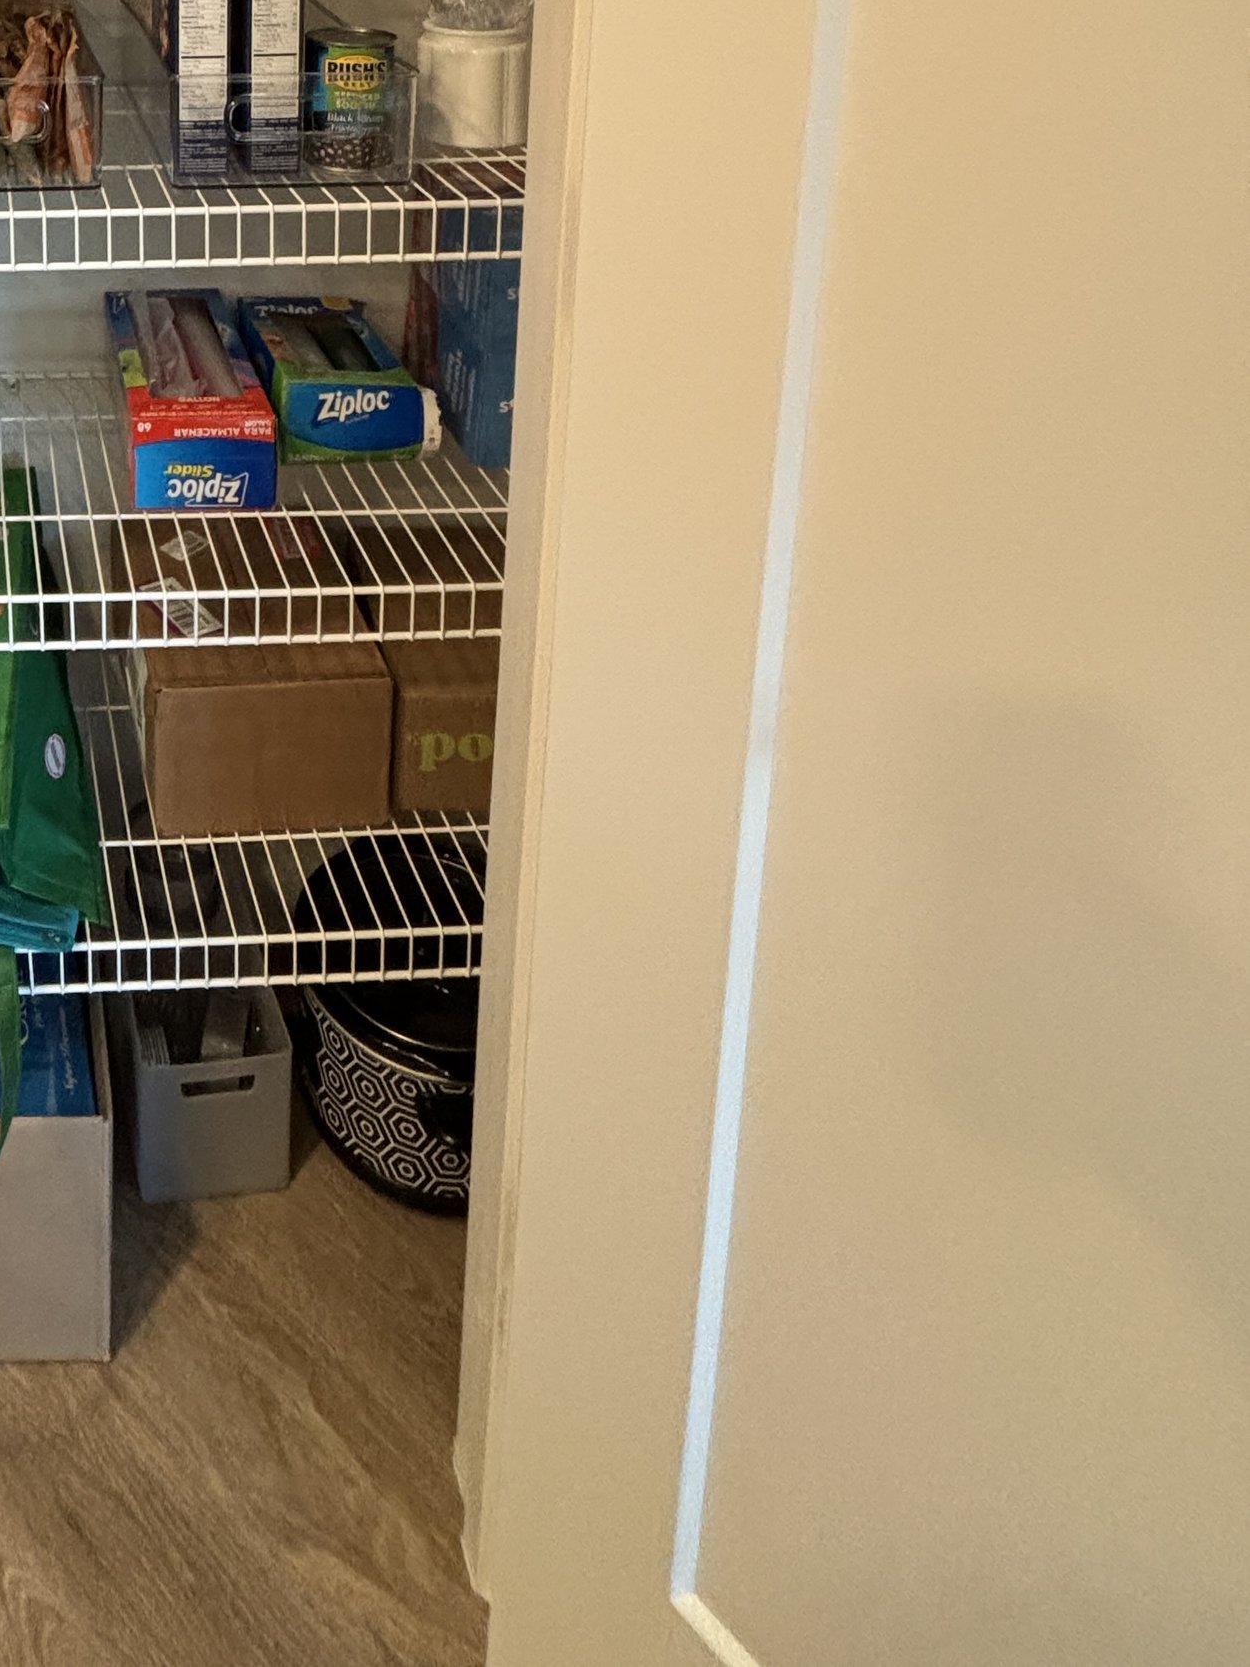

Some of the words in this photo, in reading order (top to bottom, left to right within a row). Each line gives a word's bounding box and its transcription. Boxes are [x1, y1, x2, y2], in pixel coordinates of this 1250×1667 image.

[327, 61, 386, 82] BUSH'S
[317, 389, 391, 422] Ziploc
[174, 427, 240, 437] ALMACENAR
[244, 427, 271, 435] PARA
[164, 463, 214, 477] Slider
[166, 474, 243, 503] Ziploc
[417, 731, 492, 772] po
